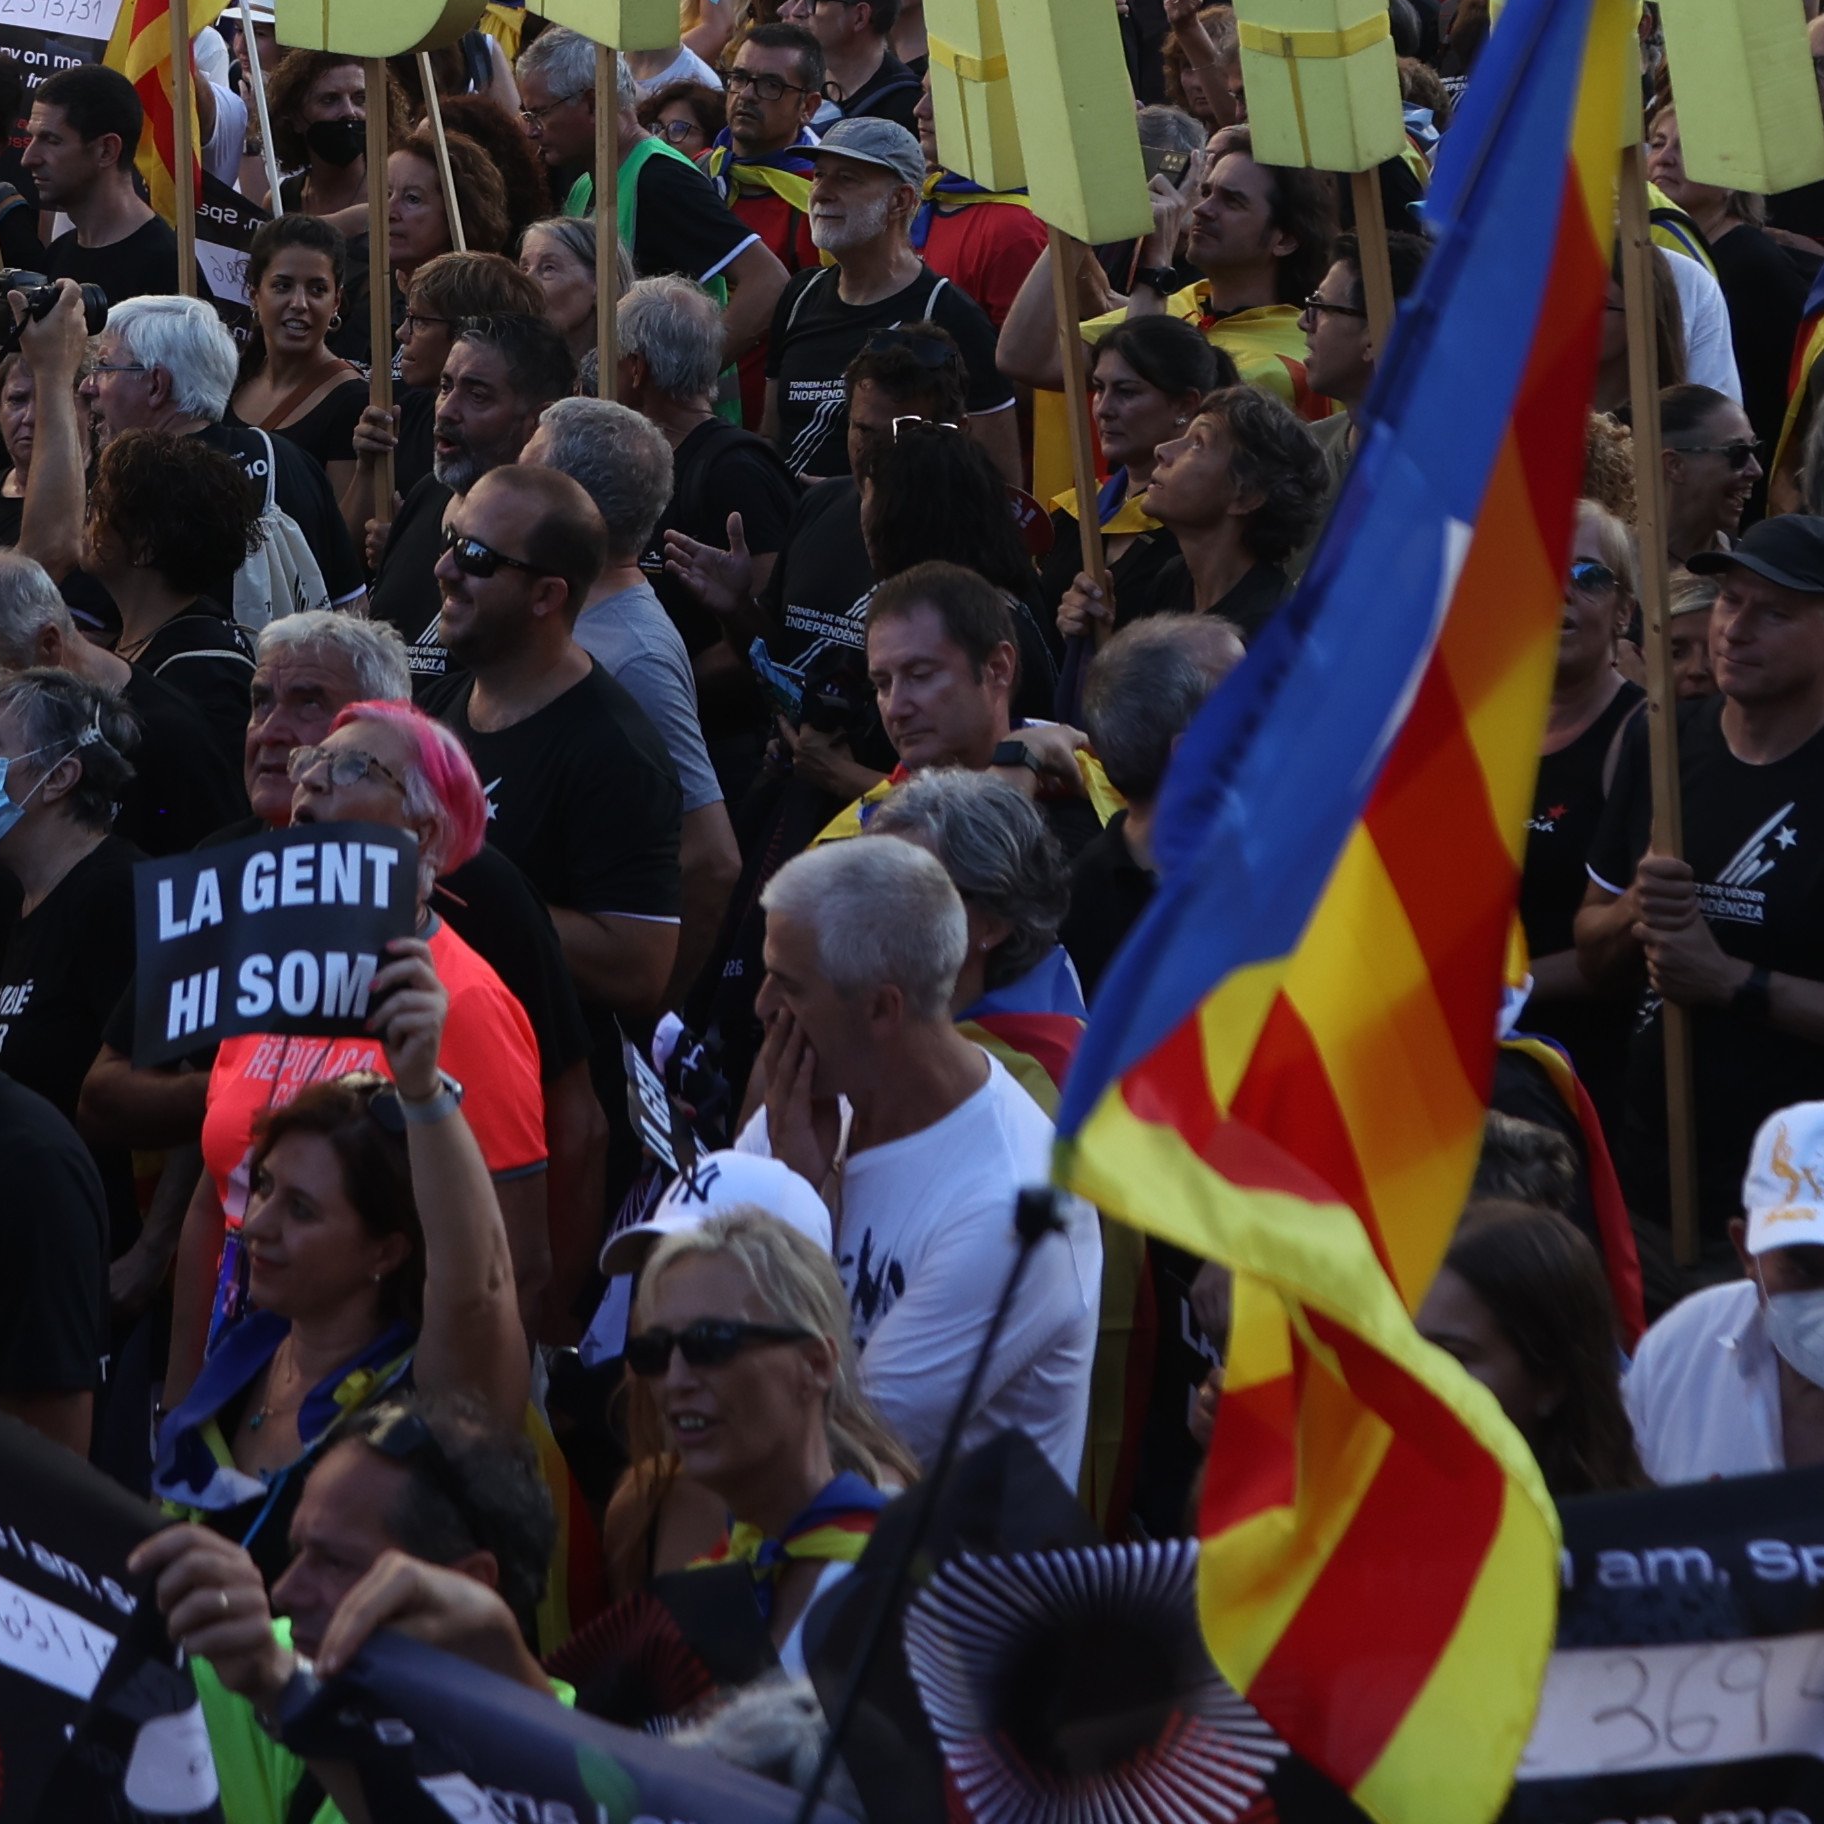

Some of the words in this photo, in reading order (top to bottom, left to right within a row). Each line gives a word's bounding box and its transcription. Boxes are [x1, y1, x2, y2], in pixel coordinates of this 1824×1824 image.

[24, 49, 49, 66] on
[245, 459, 268, 479] 10
[785, 615, 865, 645] INDEPENDÈNC
[158, 867, 223, 942] LA
[241, 842, 398, 914] GENT
[1726, 886, 1766, 903] VÈNCER
[167, 966, 220, 1041] HI
[236, 950, 377, 1018] SOM
[1592, 1644, 1776, 1768] 369
